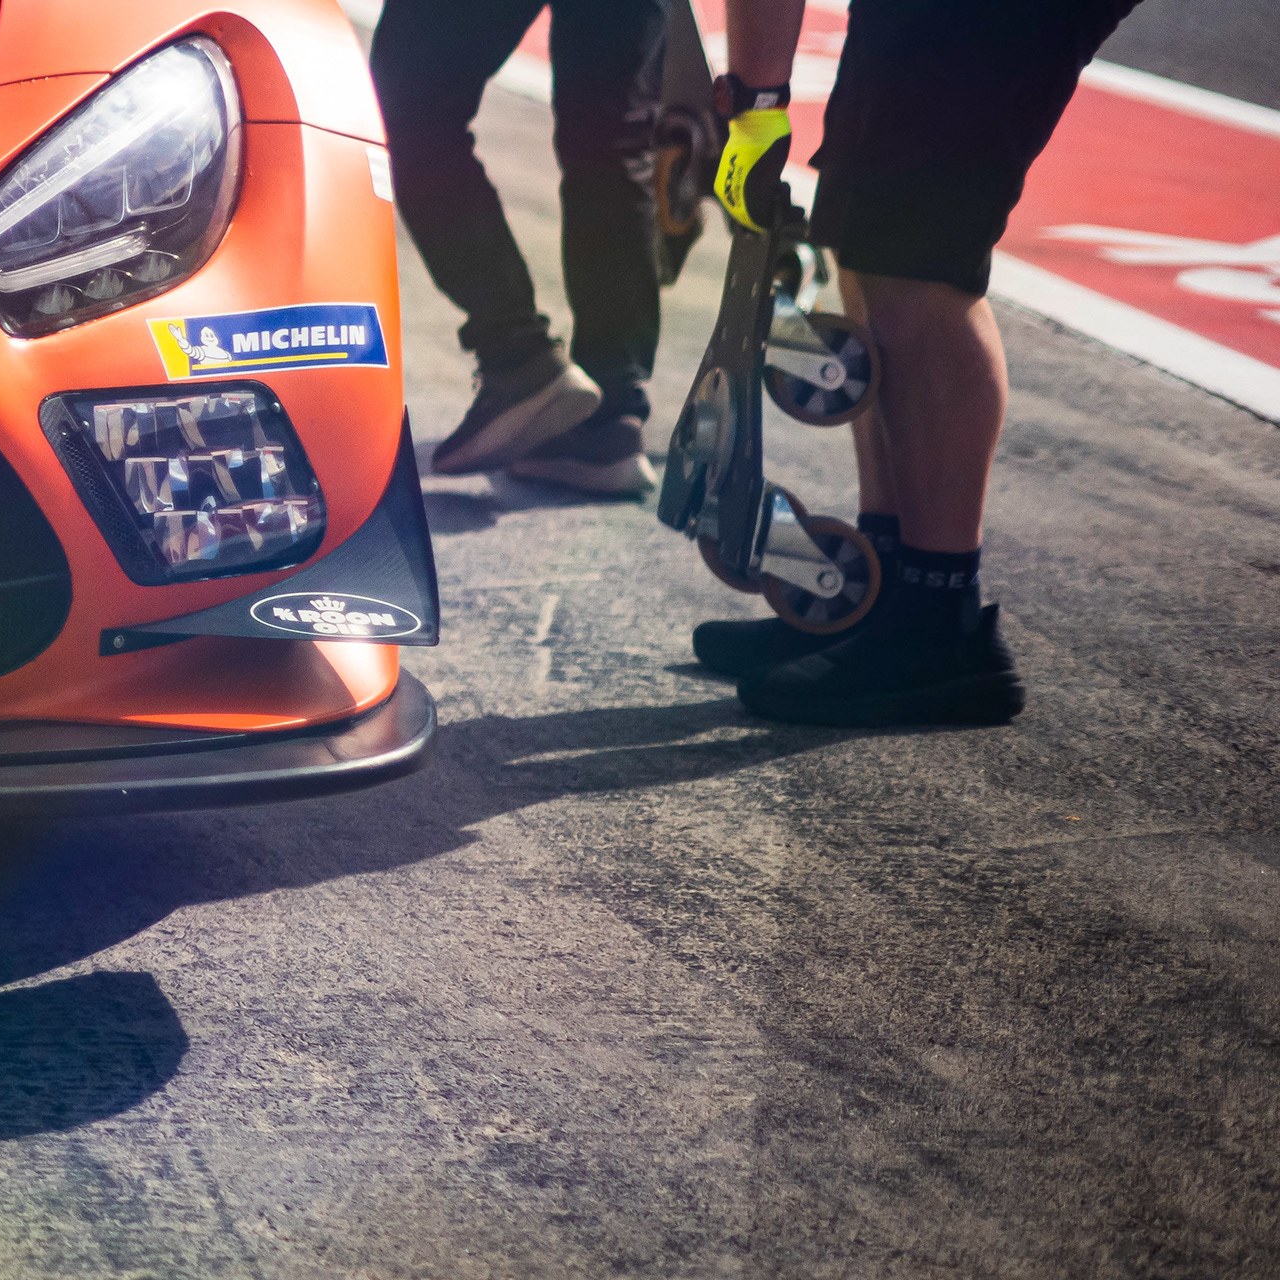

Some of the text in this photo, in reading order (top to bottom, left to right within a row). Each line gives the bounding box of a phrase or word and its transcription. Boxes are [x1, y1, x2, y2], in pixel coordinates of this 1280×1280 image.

[232, 325, 366, 354] MICHELIN
[271, 606, 397, 627] KROON
[312, 621, 368, 636] OIL
